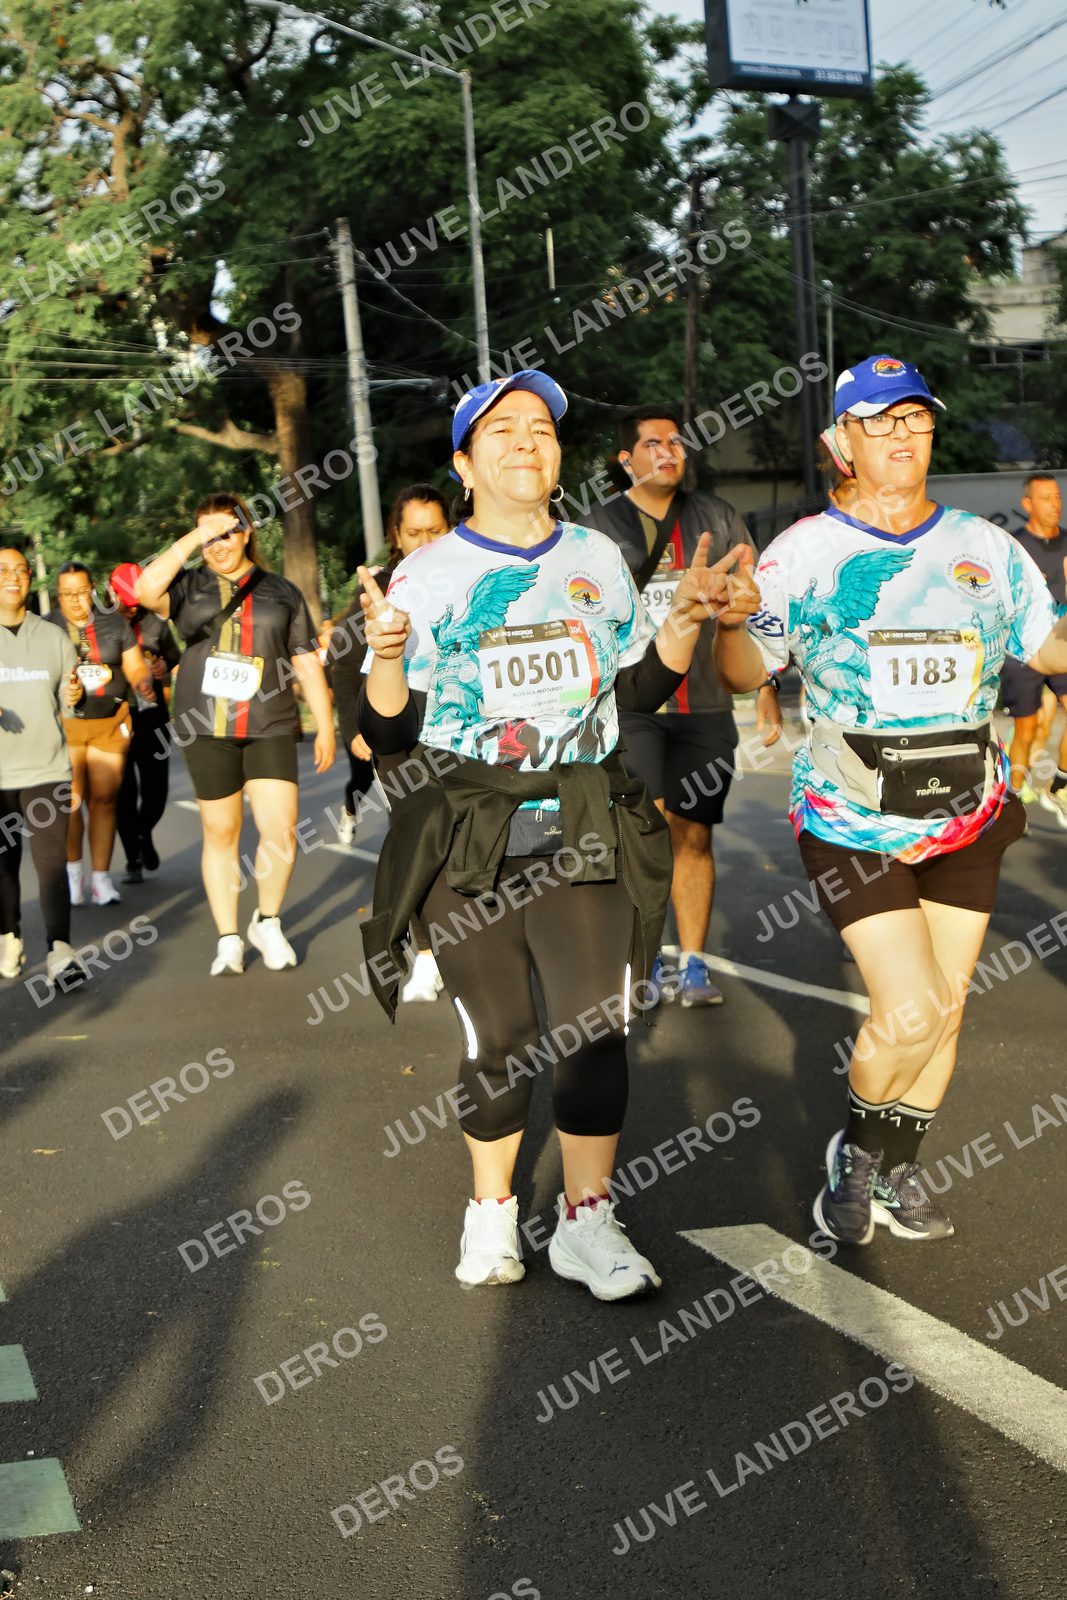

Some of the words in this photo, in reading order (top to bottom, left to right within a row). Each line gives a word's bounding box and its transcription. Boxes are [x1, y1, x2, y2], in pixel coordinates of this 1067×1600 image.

[212, 666, 249, 684] 6599
[487, 648, 579, 689] 10501
[886, 656, 957, 686] 1183
[915, 786, 952, 797] TOPTIME
